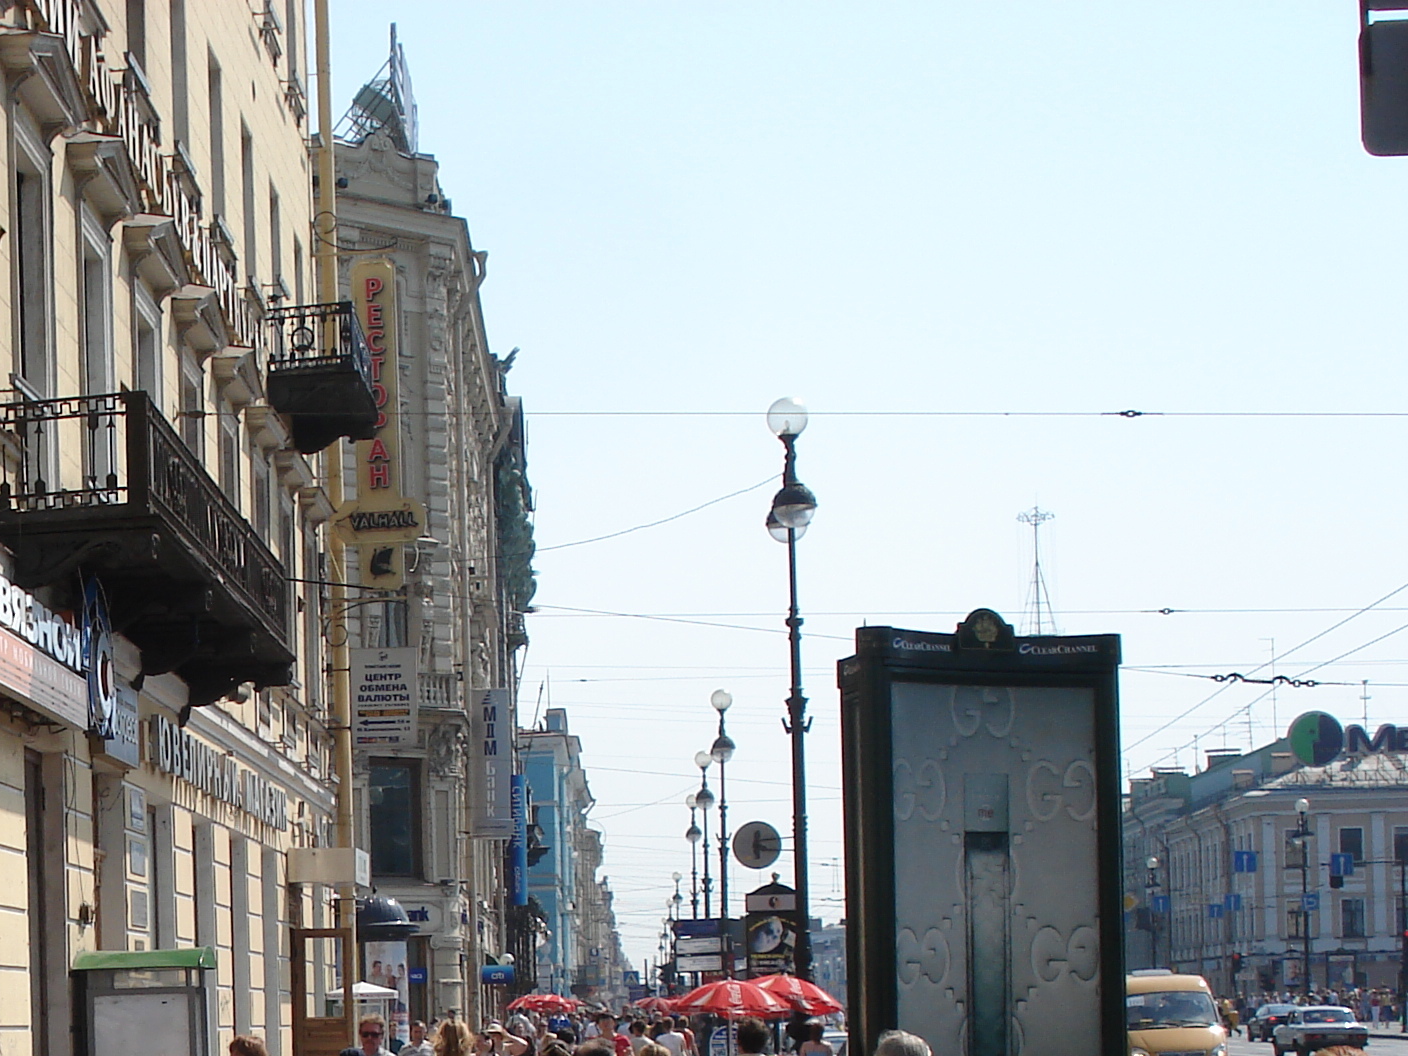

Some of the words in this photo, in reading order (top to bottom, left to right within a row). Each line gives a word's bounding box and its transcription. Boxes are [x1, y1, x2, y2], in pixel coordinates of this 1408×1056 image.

[351, 511, 419, 532] VALHALL
[364, 673, 402, 683] ЦЕНТР
[359, 683, 407, 693] ОБМЕНА
[357, 693, 410, 703] ВАЛЮТЫ
[483, 705, 497, 757] МДМ
